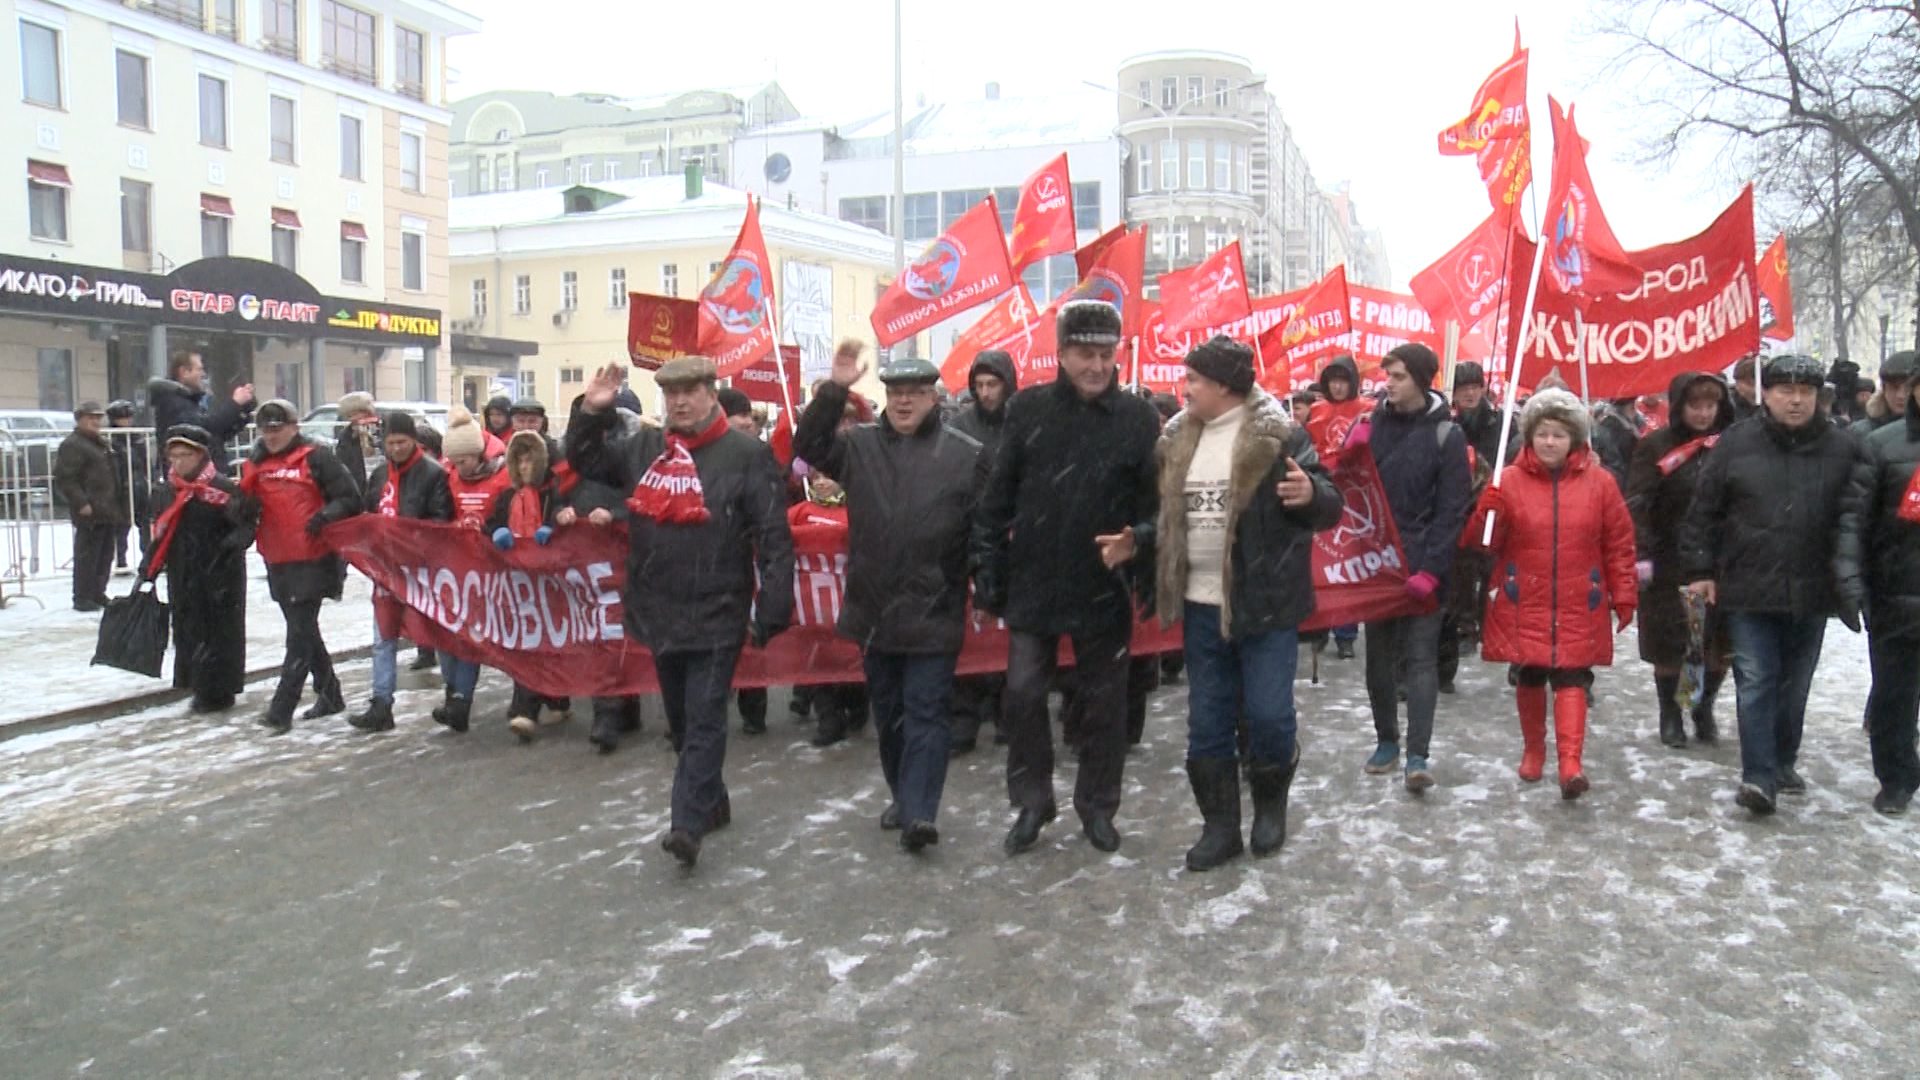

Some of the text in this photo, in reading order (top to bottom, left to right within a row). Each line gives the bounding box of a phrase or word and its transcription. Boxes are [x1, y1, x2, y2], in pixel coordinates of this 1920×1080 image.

[95, 280, 148, 307] ГРИЛЬ
[170, 289, 236, 314] СТАР
[357, 310, 439, 337] ПРОДУКТЫ
[1523, 261, 1754, 365] ЖУКОВСКИЙ
[1142, 363, 1187, 383] КПР
